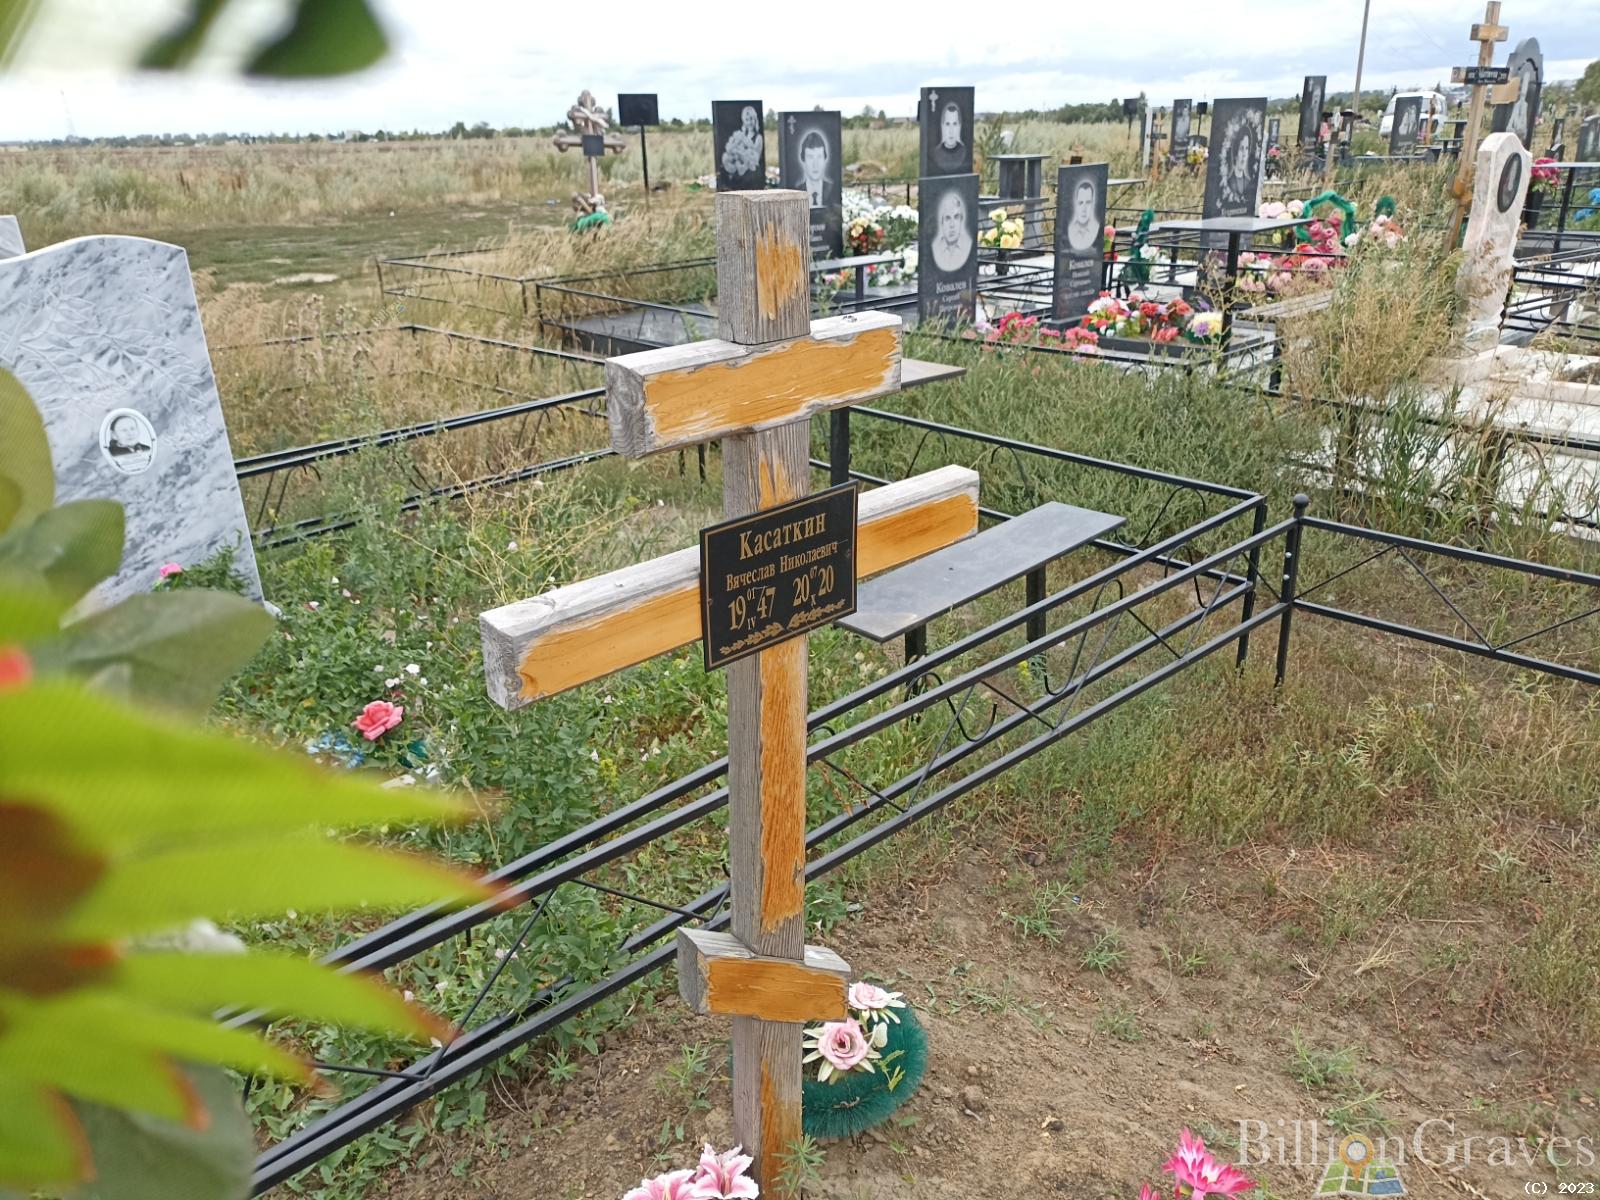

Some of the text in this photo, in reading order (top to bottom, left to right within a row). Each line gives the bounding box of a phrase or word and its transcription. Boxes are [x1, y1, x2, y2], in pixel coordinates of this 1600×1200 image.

[739, 512, 827, 561] Касаткин
[726, 542, 838, 592] Вячеслав Николаевич
[792, 574, 810, 607] 20
[817, 565, 834, 596] 20
[728, 595, 746, 631] 19
[757, 587, 776, 620] 47
